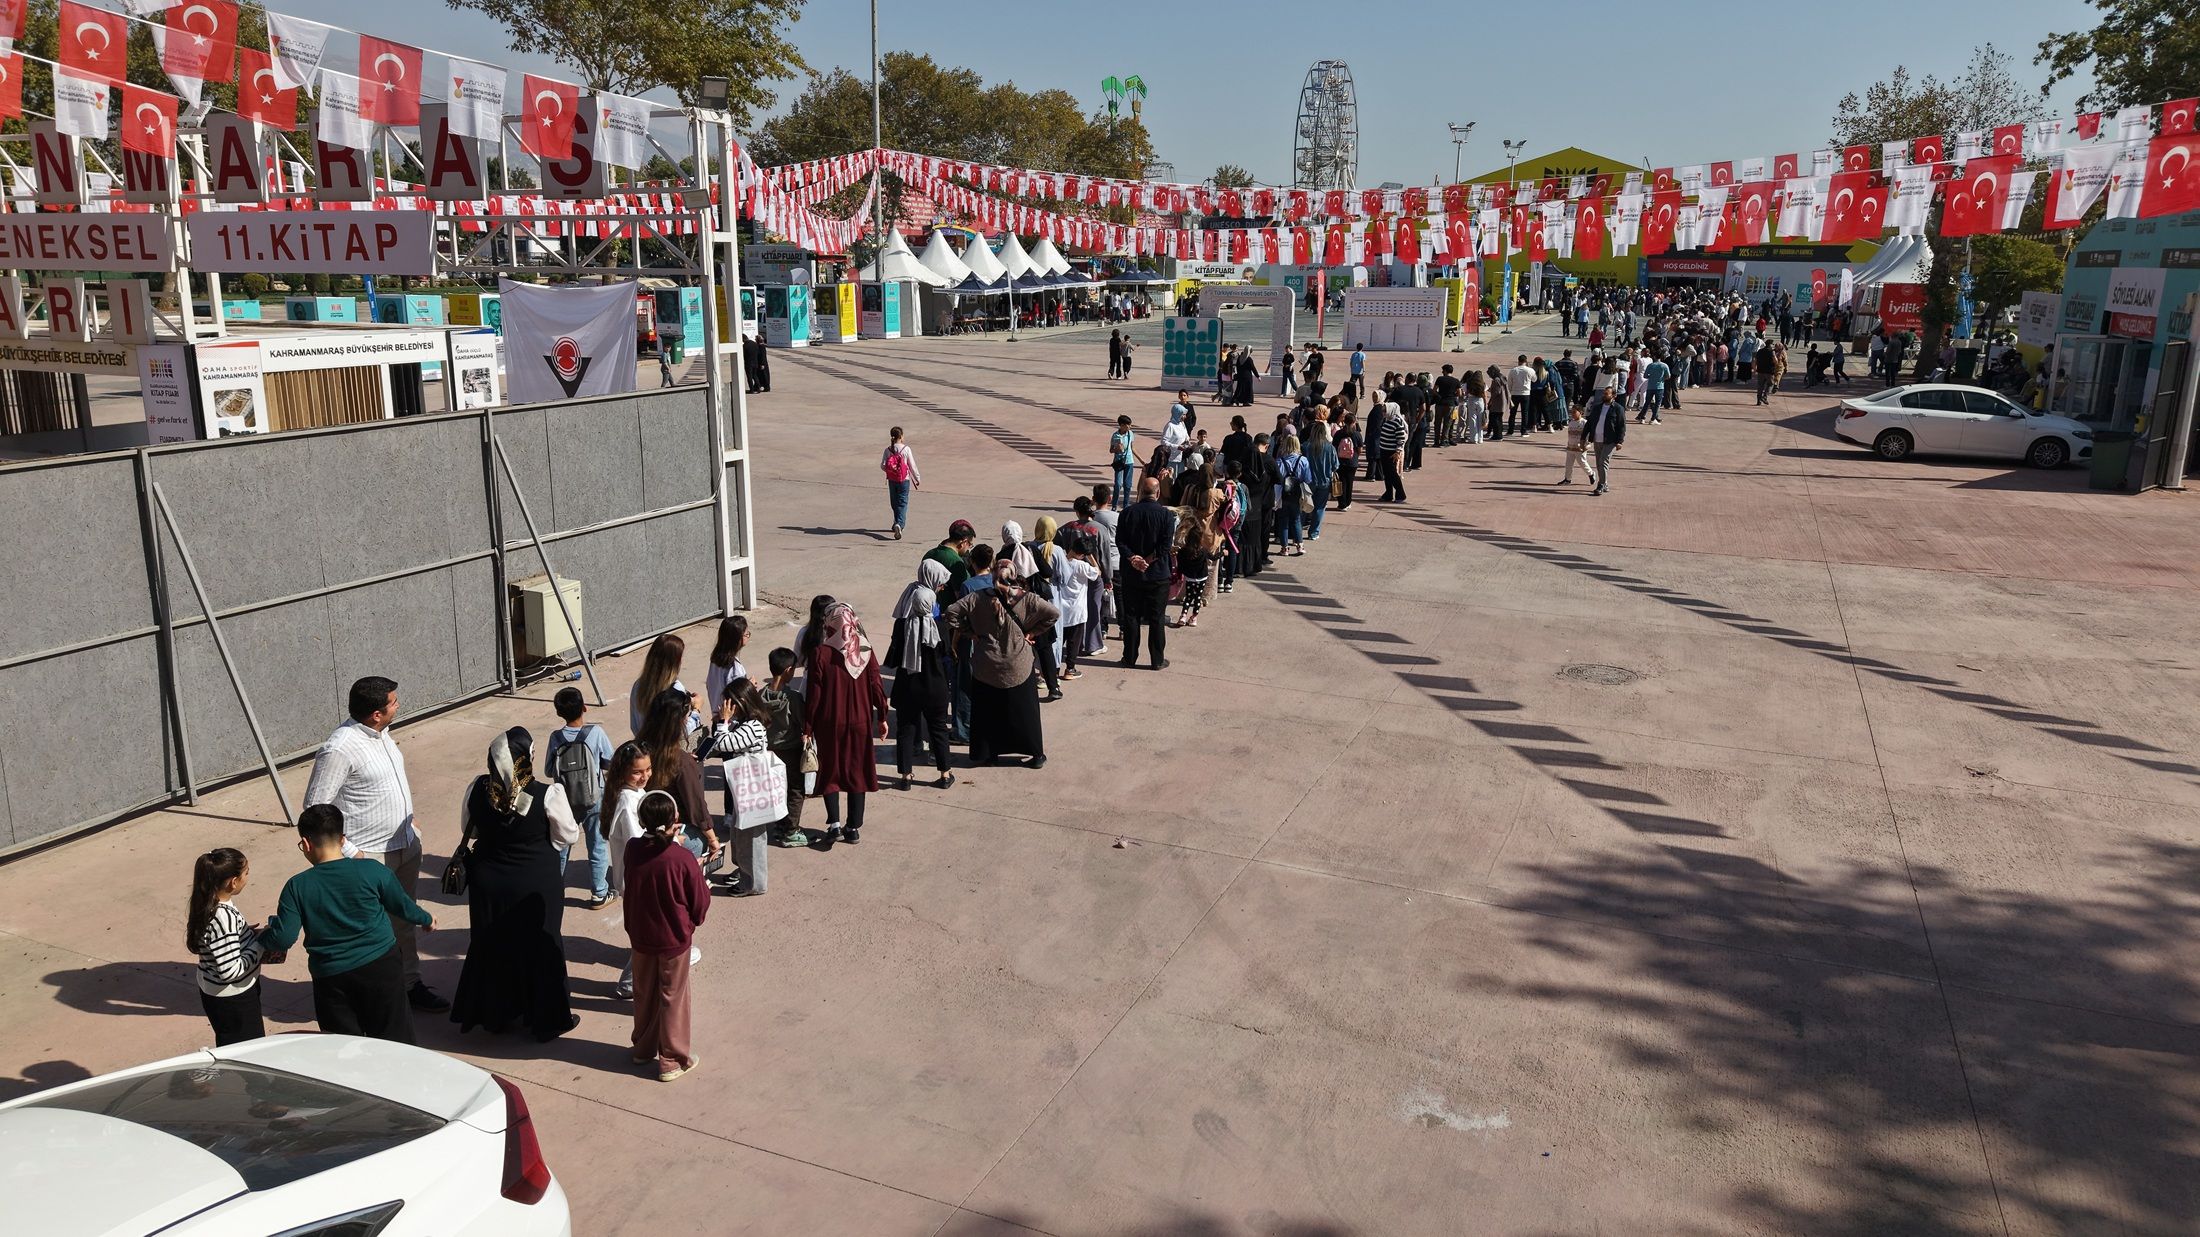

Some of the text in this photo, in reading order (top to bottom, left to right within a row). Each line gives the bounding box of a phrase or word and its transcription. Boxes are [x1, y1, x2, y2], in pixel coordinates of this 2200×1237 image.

[1195, 265, 1215, 274] KİTAP
[1663, 262, 1709, 270] HOŞ GELDİNİZ
[270, 341, 434, 358] KAHRAMANMARAŞ BÜYÜKŞEHİR BELEDİYESİ
[203, 372, 259, 380] KAHRAMANMARAŞ
[732, 764, 769, 780] FEEL
[735, 776, 782, 797] GOOD
[737, 791, 783, 814] STORE
